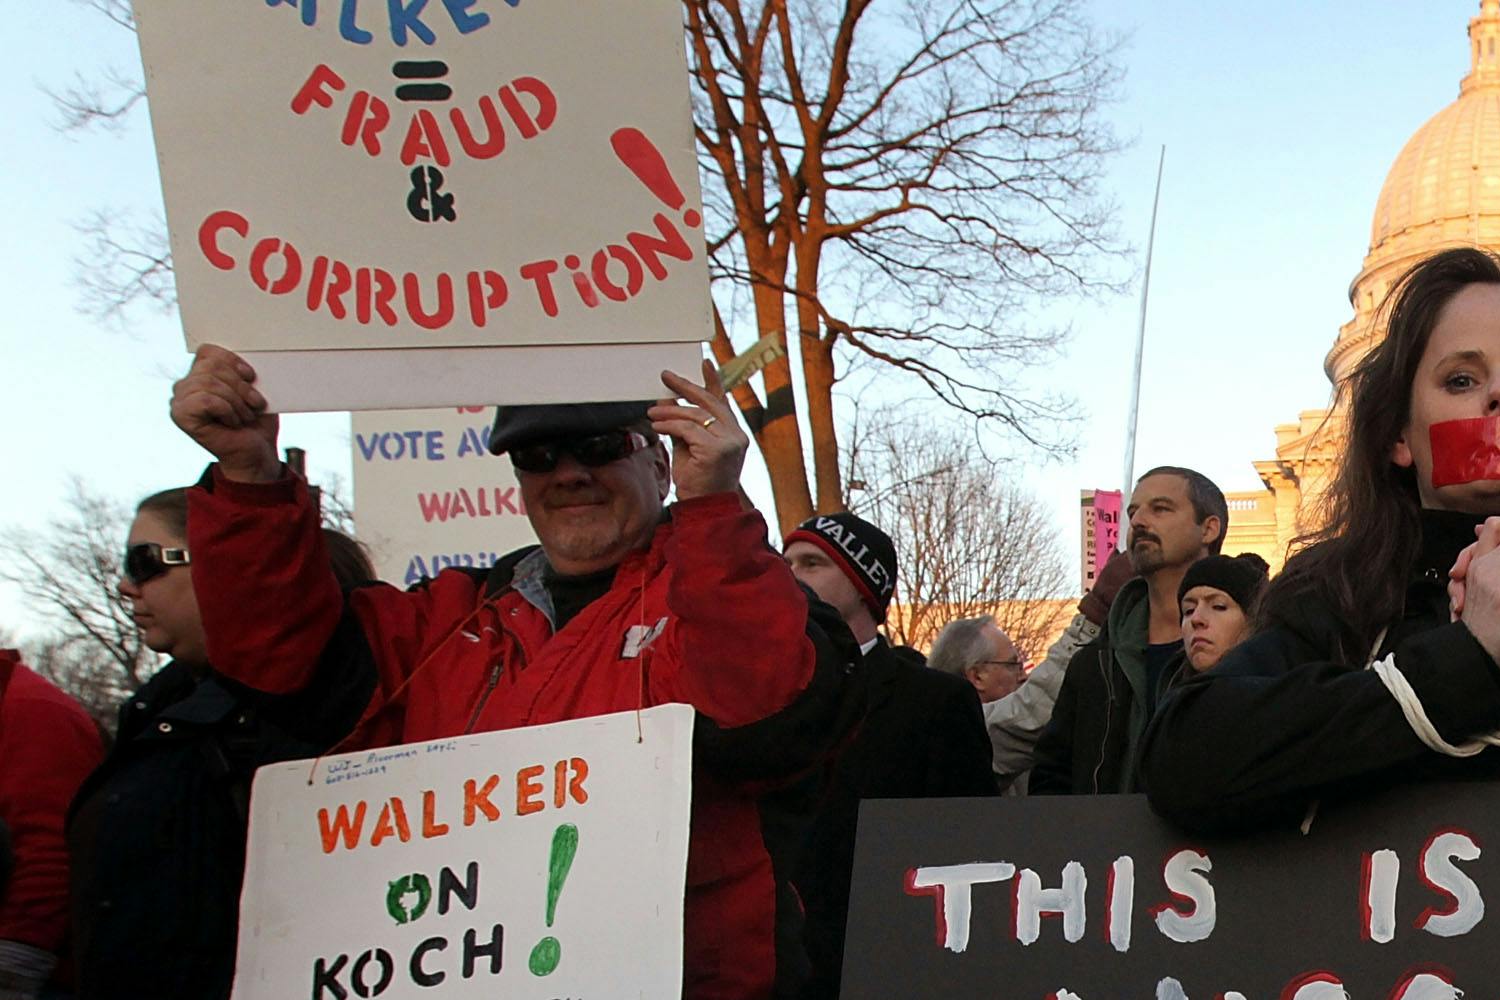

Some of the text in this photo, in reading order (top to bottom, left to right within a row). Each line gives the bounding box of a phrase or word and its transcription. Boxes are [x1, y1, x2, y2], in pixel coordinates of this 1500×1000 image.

[291, 63, 557, 166] FRAUD
[406, 165, 456, 223] &
[356, 431, 445, 461] VOTE
[815, 517, 892, 595] VALLEY
[317, 756, 589, 855] WALKER
[385, 861, 479, 926] ON
[904, 846, 1217, 952] THIS
[1360, 825, 1485, 944] IS
